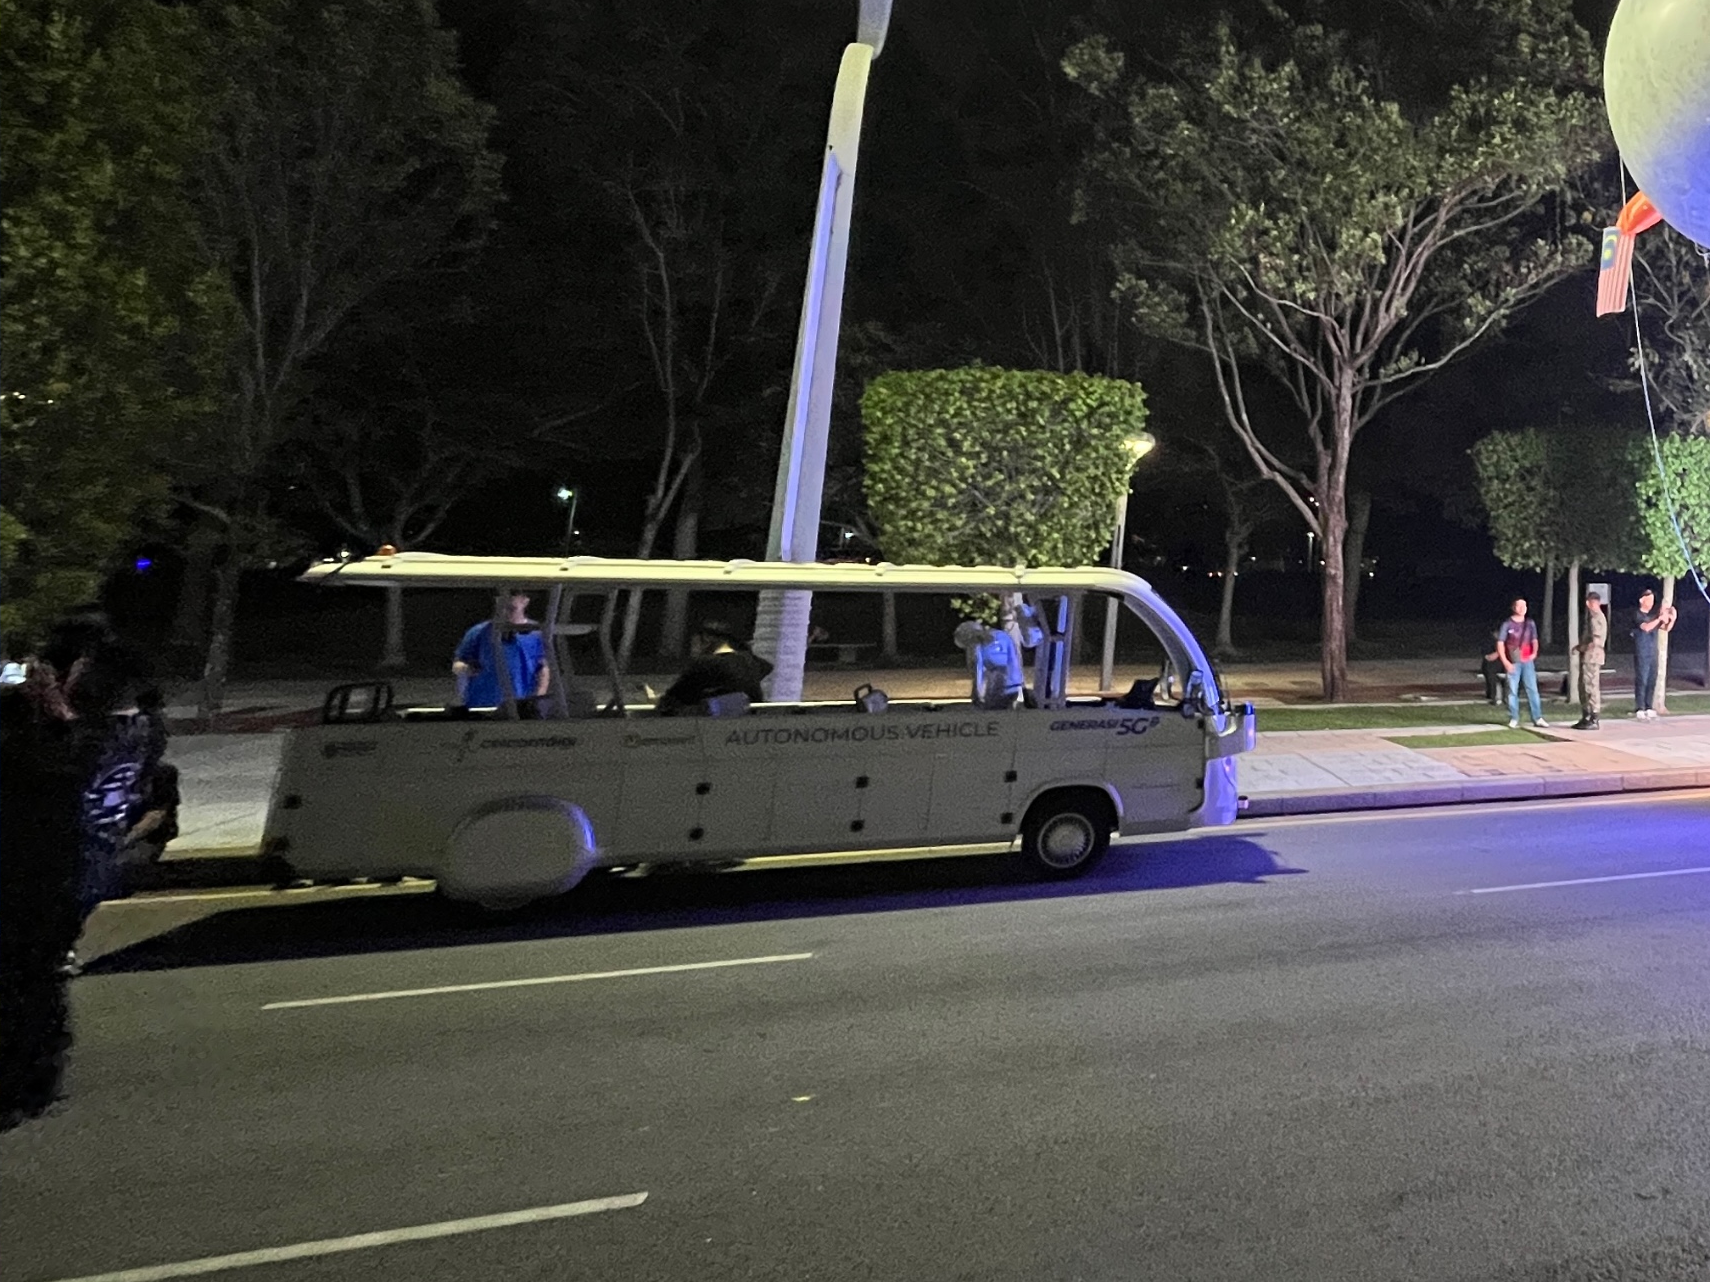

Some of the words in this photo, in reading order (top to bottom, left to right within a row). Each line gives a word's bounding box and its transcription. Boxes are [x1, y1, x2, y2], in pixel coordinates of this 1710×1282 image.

[725, 725, 900, 747] AUTONOMOUS
[906, 721, 1001, 739] VEHICLE
[1049, 719, 1118, 731] GENERASI
